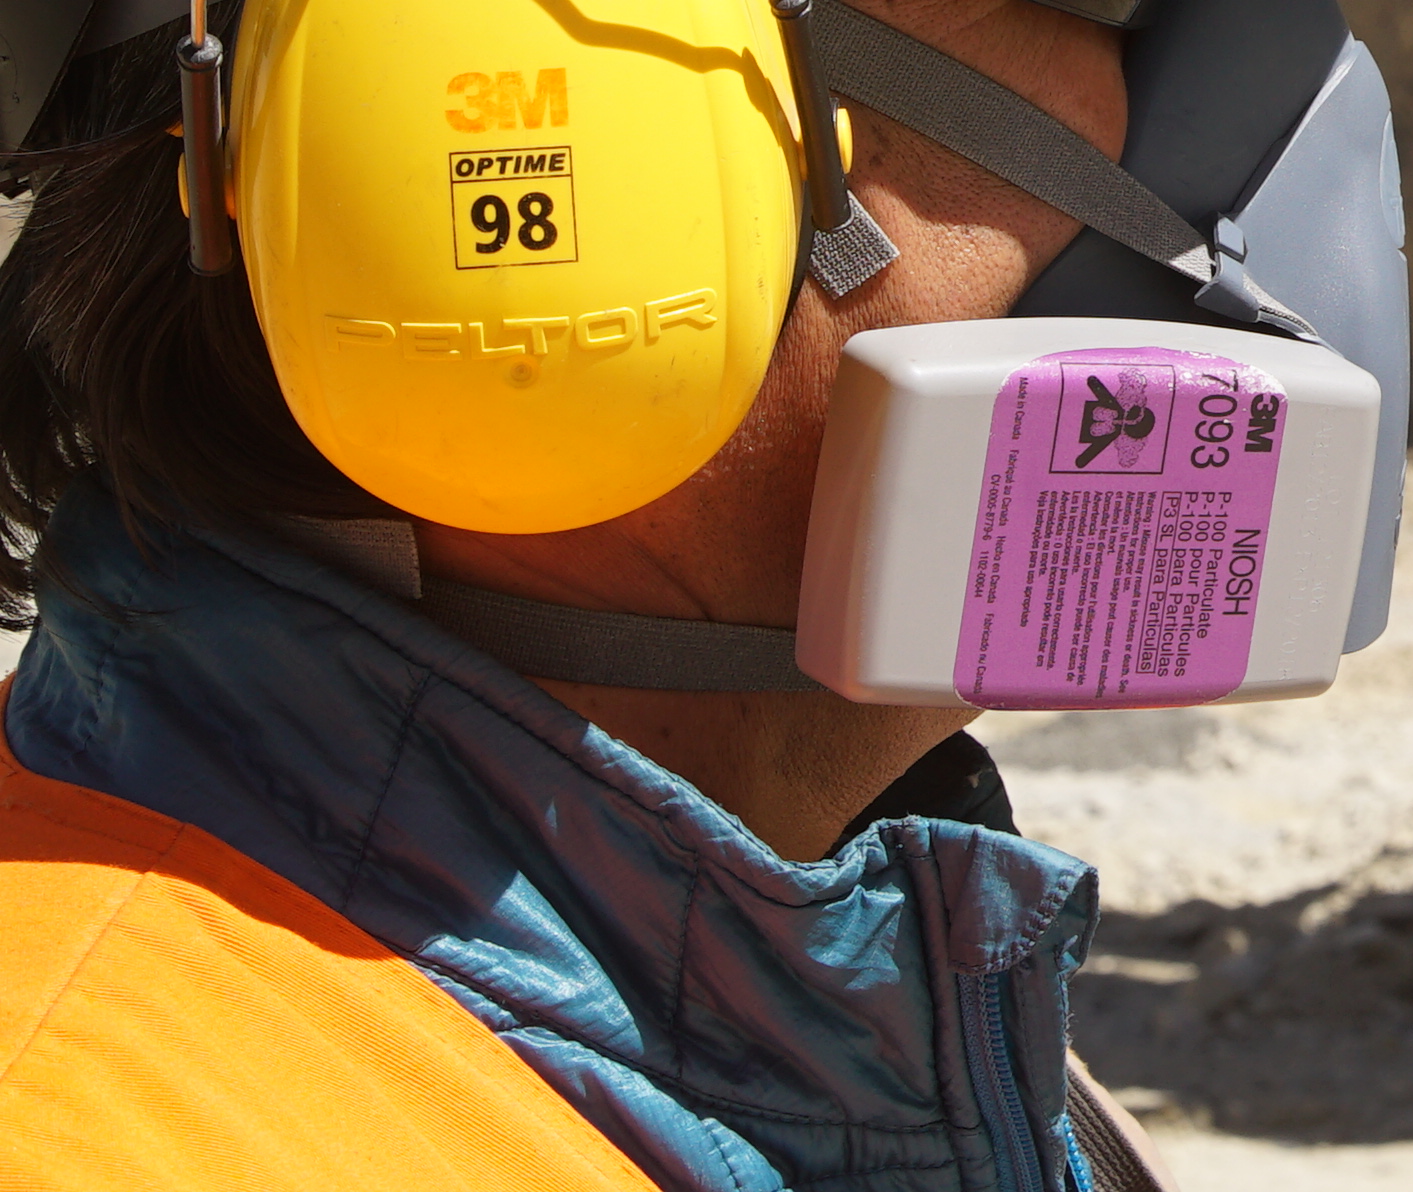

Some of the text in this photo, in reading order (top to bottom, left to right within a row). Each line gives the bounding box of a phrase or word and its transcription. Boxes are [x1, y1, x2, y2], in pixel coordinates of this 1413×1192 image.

[445, 67, 570, 134] 3M
[455, 153, 567, 177] OPTIME
[470, 192, 558, 254] 98
[324, 287, 718, 361] PELTOR
[1189, 369, 1240, 469] 7093
[1244, 394, 1280, 452] 3M
[1140, 496, 1178, 670] P3 SL para Particulas
[1156, 491, 1198, 677] P-100 para Particulas
[1173, 491, 1215, 677] P-100 pour Particules
[1195, 491, 1231, 638] P-100 Particulate
[1222, 529, 1260, 615] NIOSH
